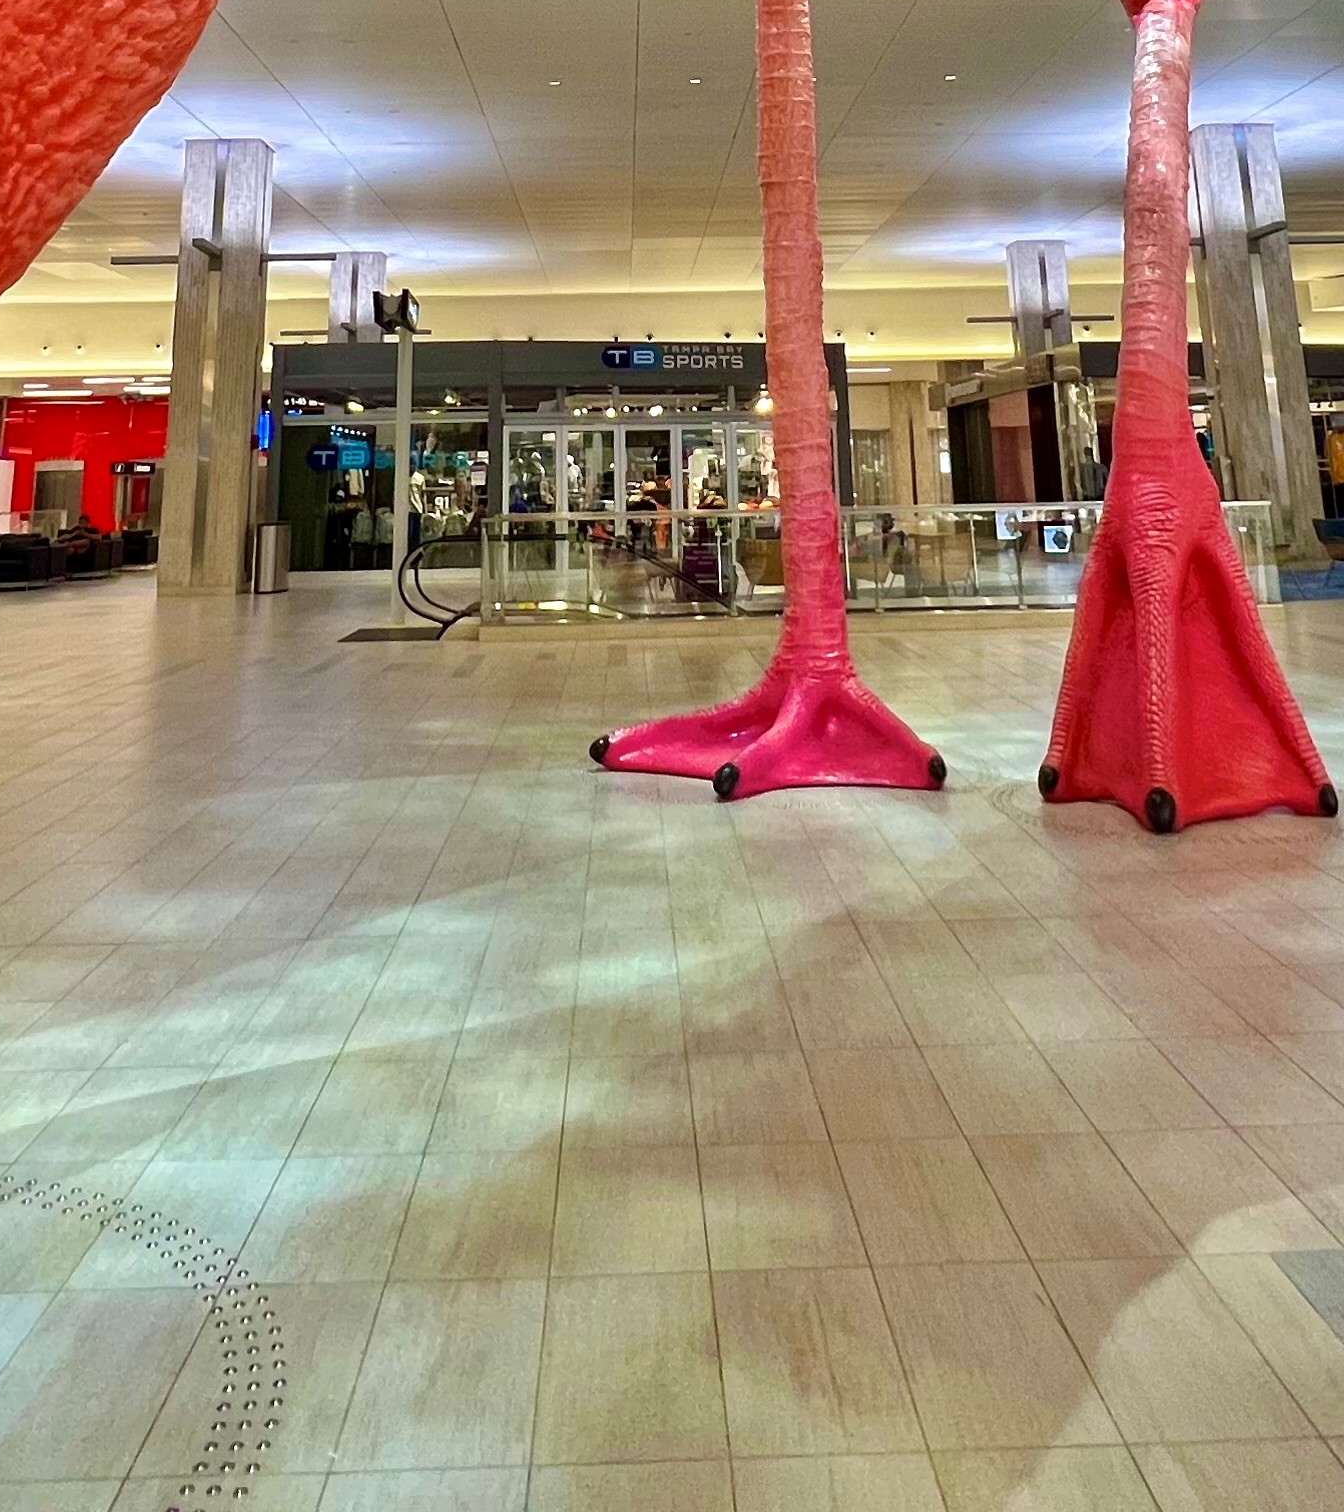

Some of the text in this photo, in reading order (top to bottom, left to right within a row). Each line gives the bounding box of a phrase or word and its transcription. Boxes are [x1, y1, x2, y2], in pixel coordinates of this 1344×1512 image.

[606, 350, 655, 365] TB
[662, 355, 744, 369] SPORTS
[313, 450, 365, 466] TB
